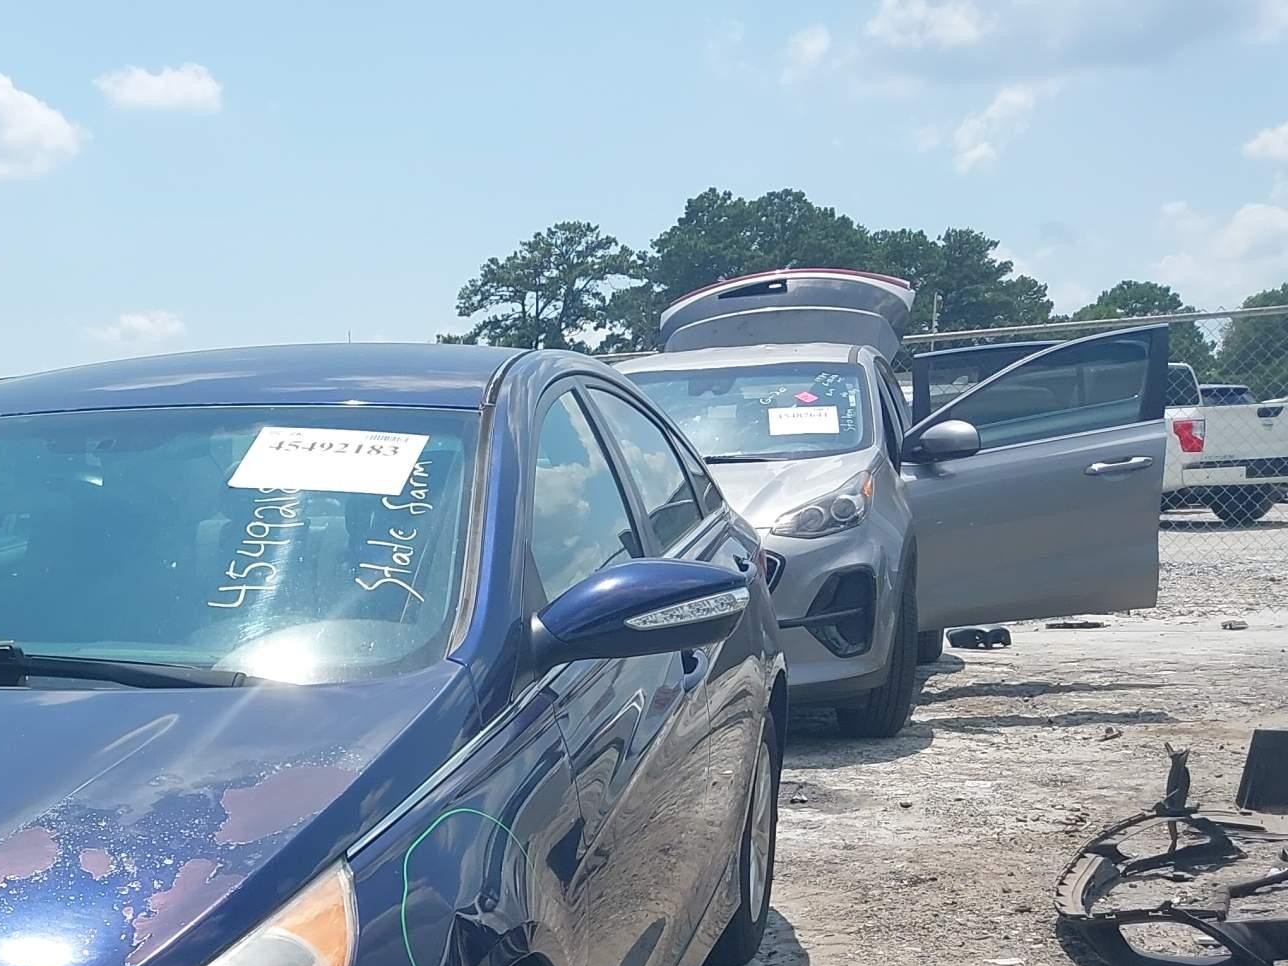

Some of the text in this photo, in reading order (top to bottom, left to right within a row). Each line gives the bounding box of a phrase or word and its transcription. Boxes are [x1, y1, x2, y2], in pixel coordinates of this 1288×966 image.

[268, 439, 400, 457] 45492183
[207, 488, 305, 608] 454921
[355, 460, 433, 602] State Farm
